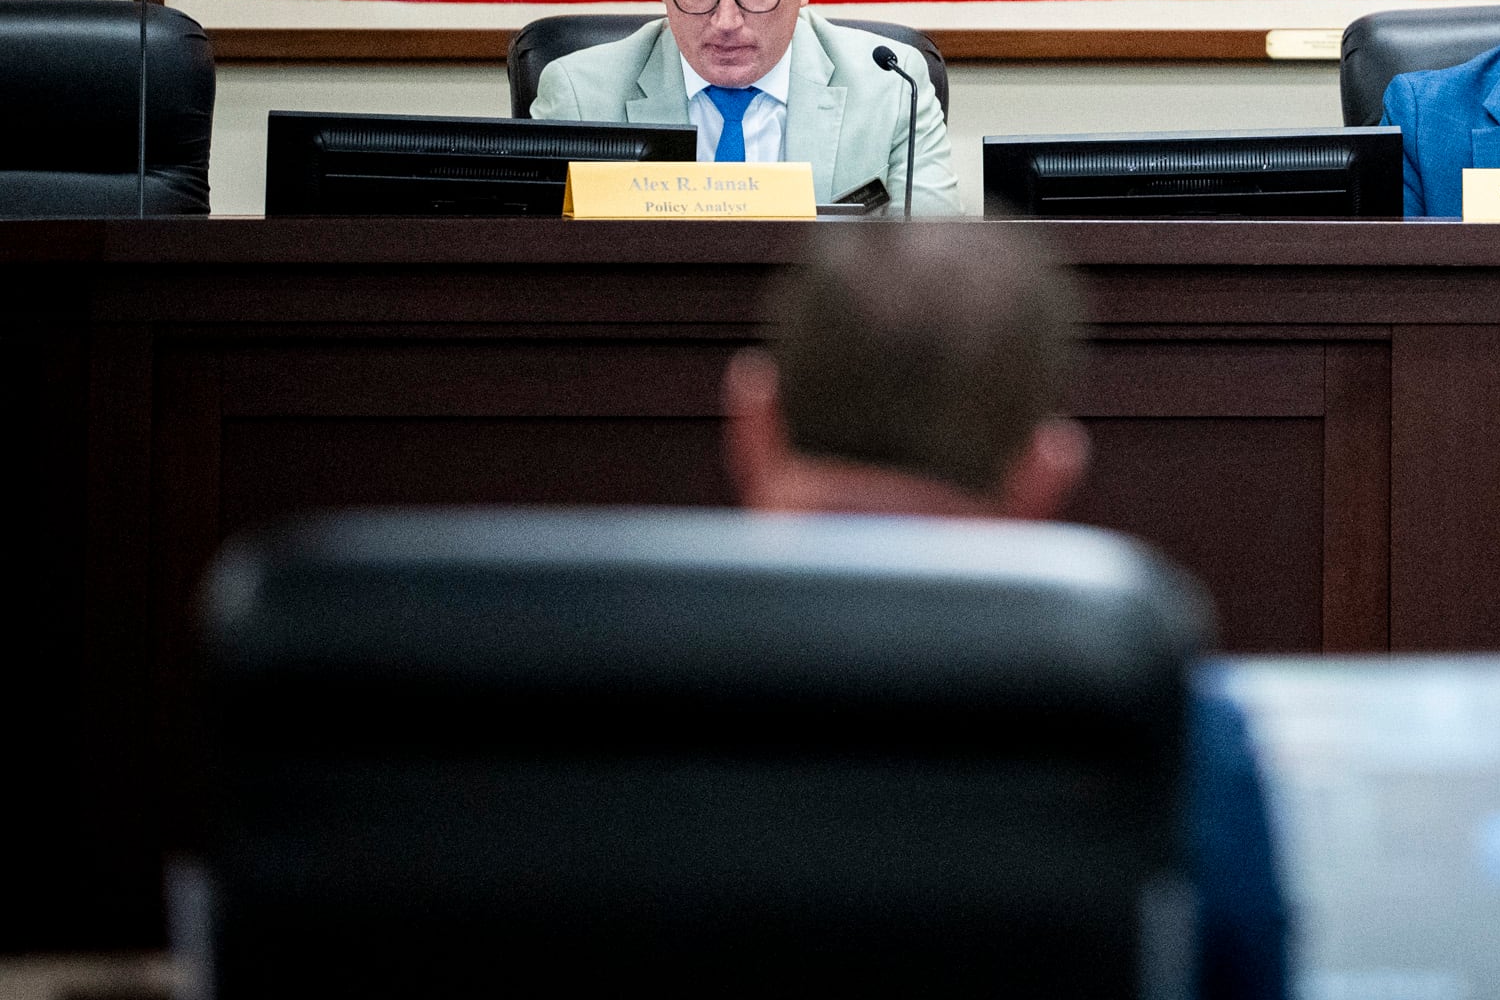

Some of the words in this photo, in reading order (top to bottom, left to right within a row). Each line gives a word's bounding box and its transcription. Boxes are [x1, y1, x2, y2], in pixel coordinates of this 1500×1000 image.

[628, 177, 670, 191] Alex
[677, 177, 697, 191] R.
[703, 177, 760, 191] Janak
[645, 201, 688, 213] Policy
[694, 202, 747, 215] Analyst
